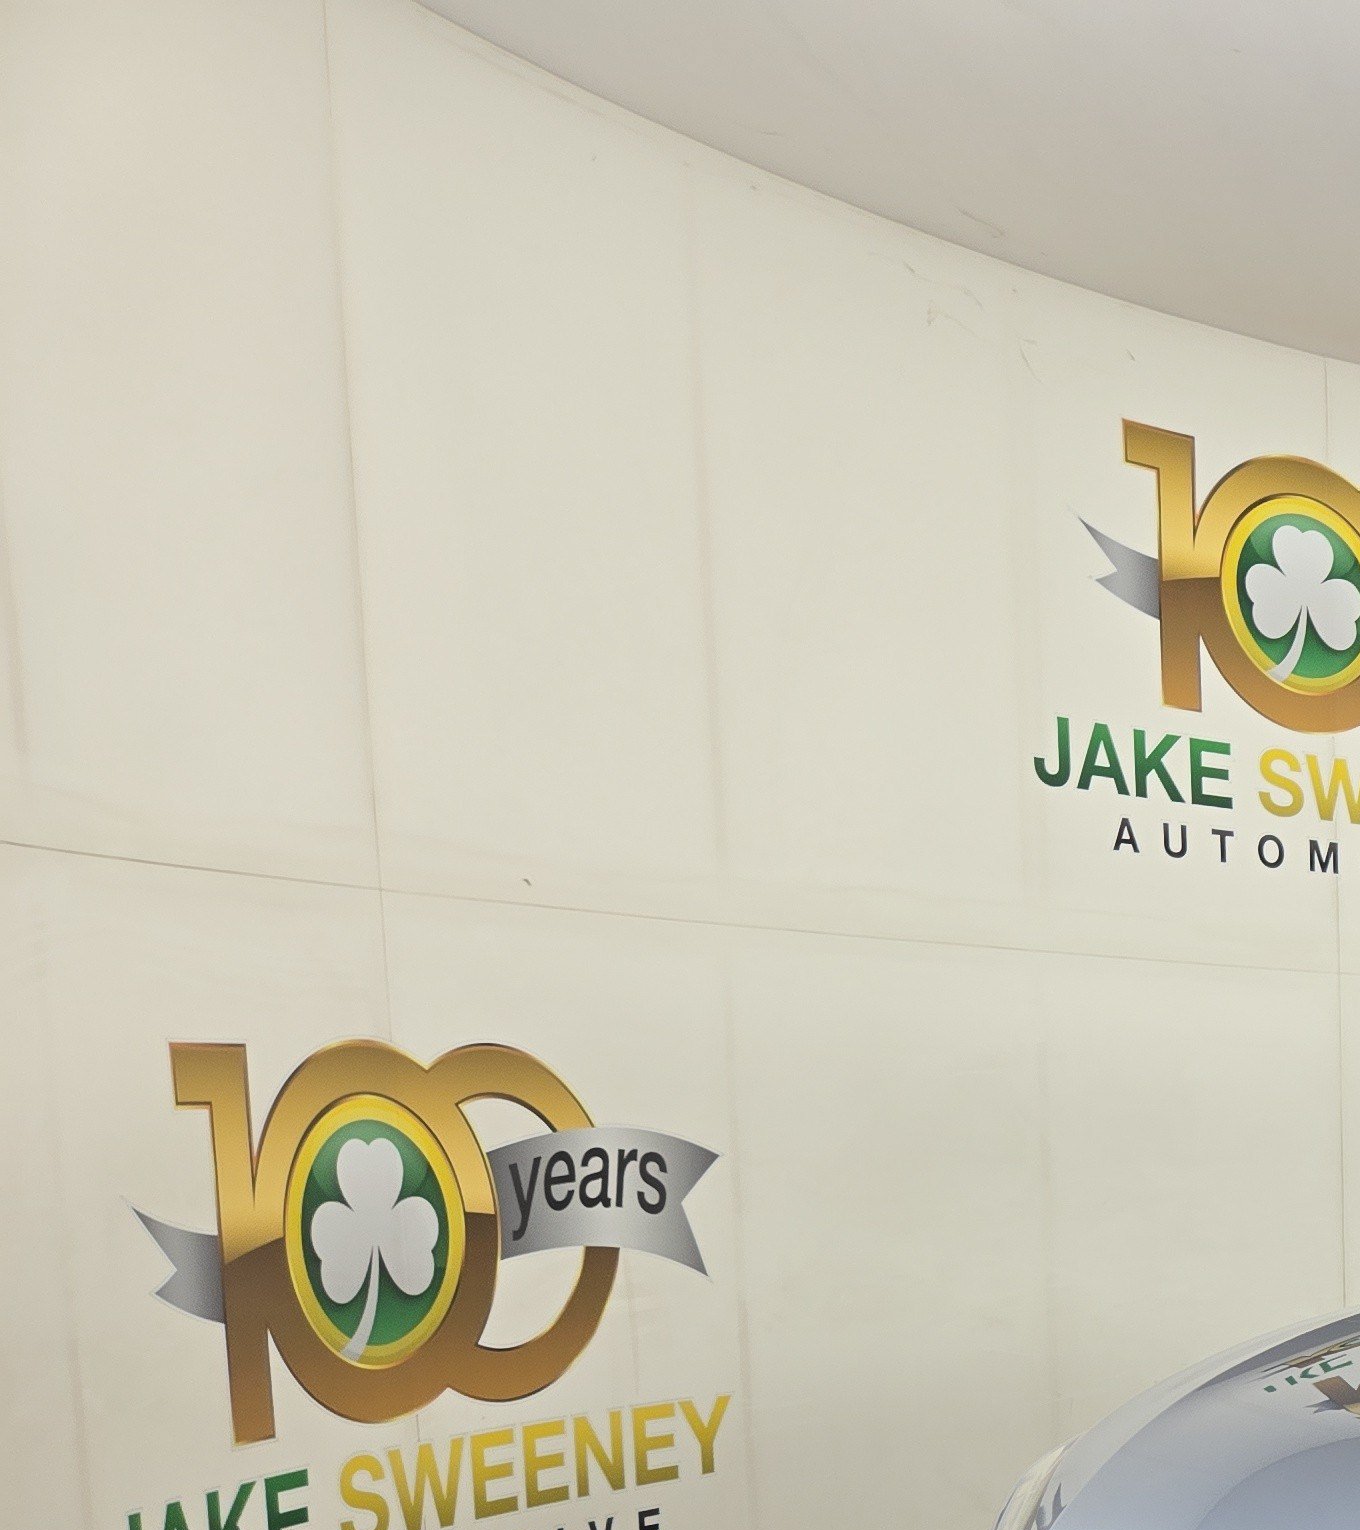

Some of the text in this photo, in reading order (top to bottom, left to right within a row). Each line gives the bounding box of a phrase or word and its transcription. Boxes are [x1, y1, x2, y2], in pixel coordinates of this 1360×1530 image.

[1033, 715, 1234, 810] JAKE
[508, 1146, 668, 1242] years
[168, 1038, 621, 1447] 100
